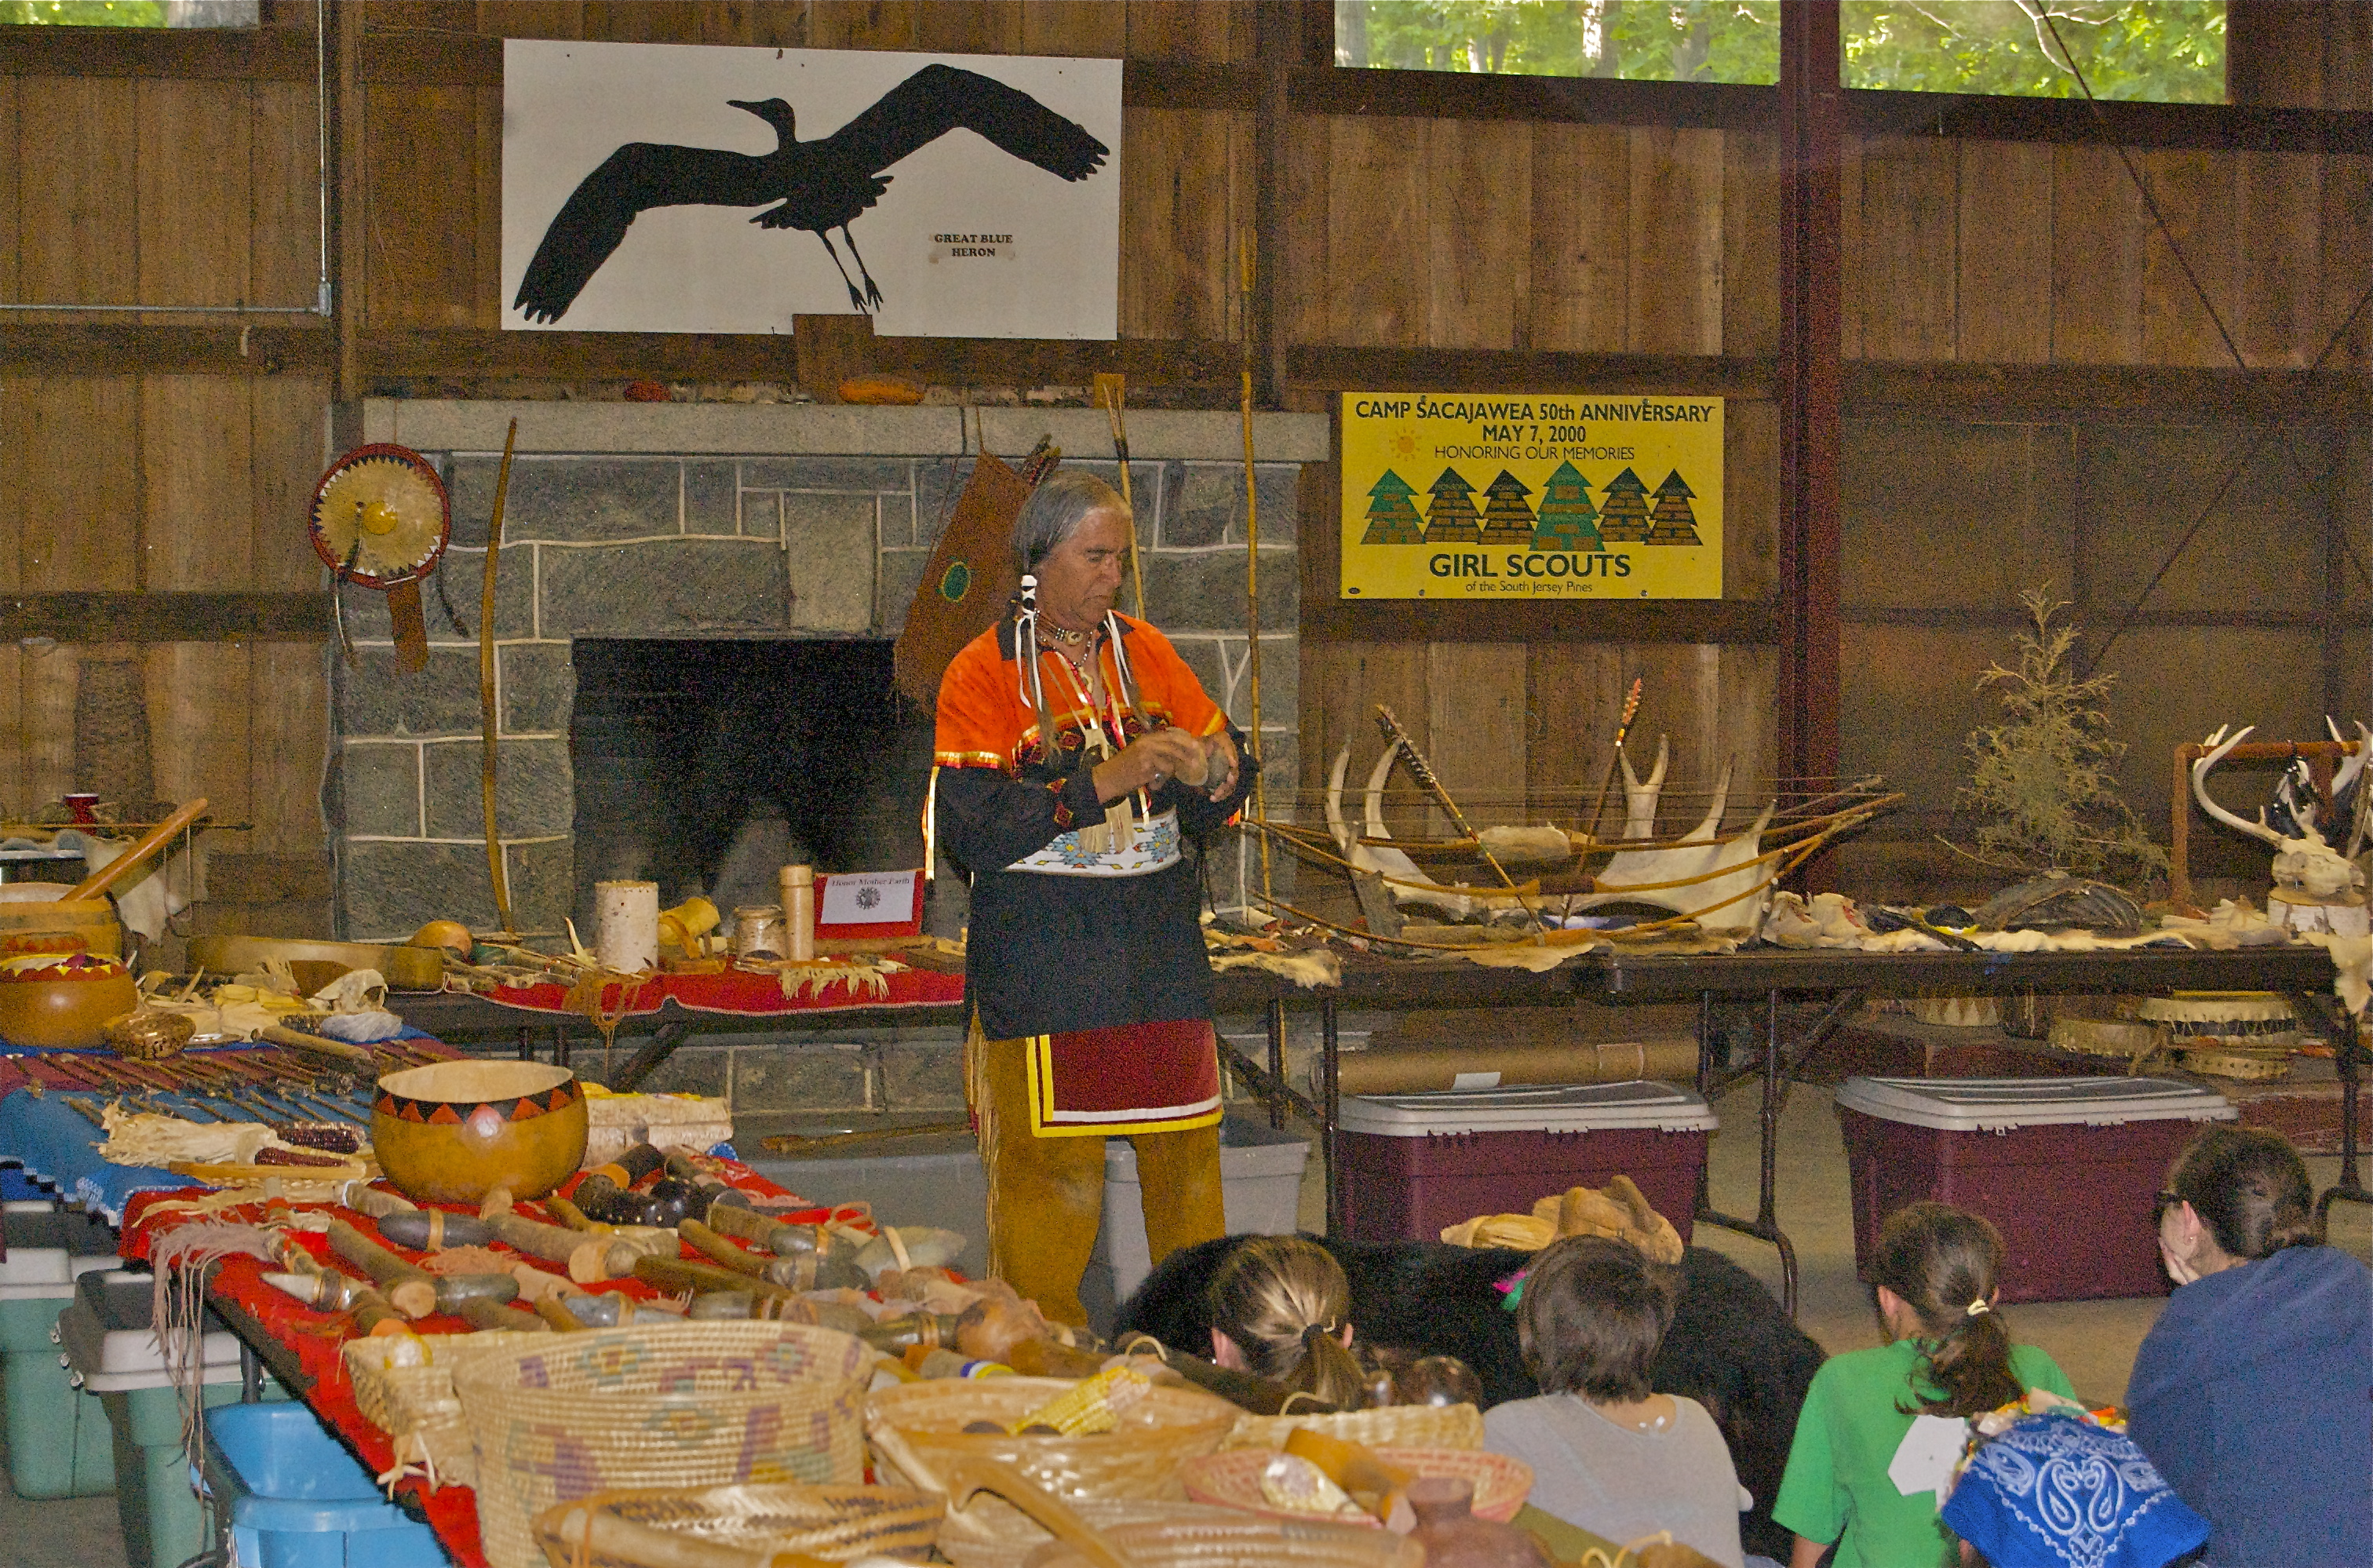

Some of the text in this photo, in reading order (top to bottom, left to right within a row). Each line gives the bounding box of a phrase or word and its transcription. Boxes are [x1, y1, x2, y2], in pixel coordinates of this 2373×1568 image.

[934, 234, 1013, 244] GREAT BLUE
[951, 247, 996, 257] HERON
[1355, 401, 1712, 424] CAMP SACAJAWEA 50th ANNIVERSARY
[1482, 425, 1586, 445] MAY 7, 2000
[1434, 446, 1635, 460] HONORING OUR MEMORIES
[1429, 554, 1631, 578] GIRL SCOUTS
[1465, 581, 1592, 595] of the South Jersey Pines
